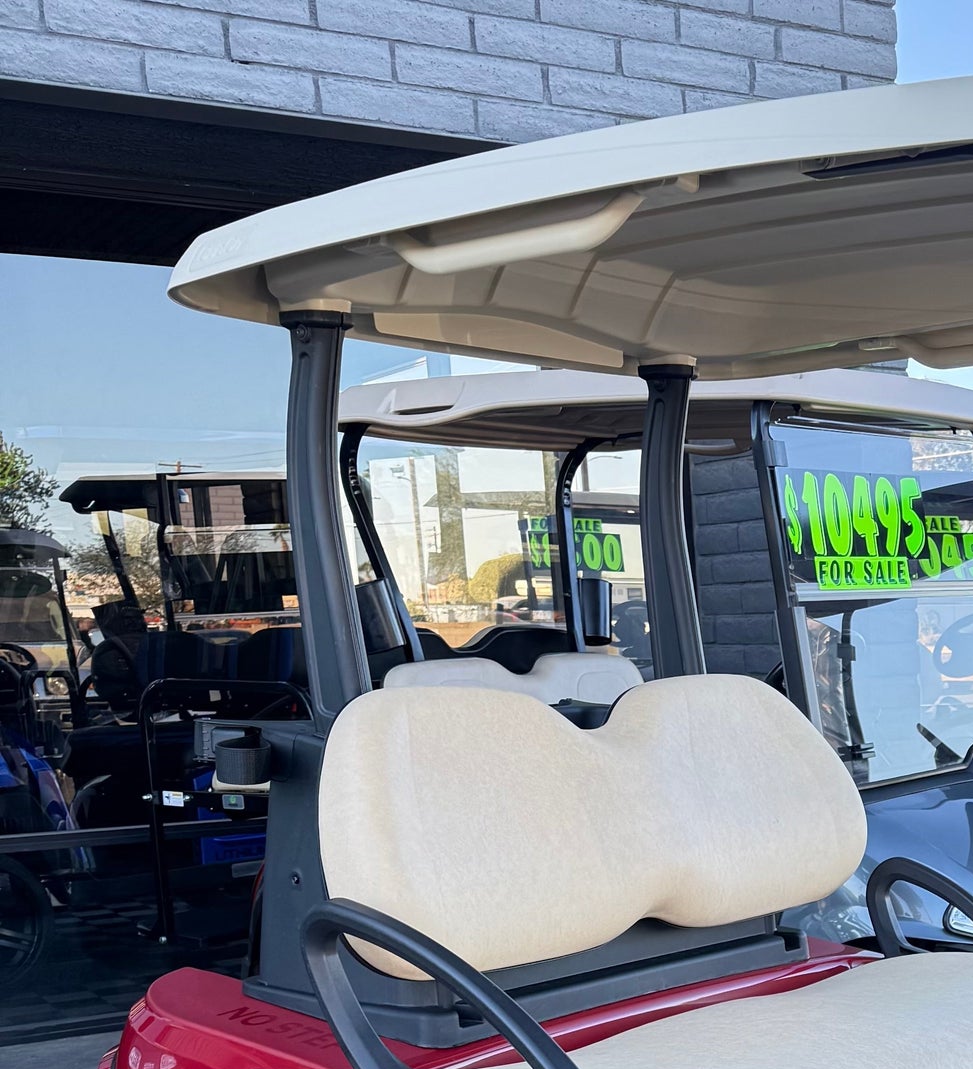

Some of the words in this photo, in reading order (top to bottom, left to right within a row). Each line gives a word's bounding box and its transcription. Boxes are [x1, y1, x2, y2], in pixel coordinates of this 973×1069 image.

[530, 518, 549, 530] FO
[574, 519, 602, 532] ALE
[784, 471, 926, 559] $10495
[927, 517, 959, 532] ALE
[818, 560, 857, 587] FOR
[863, 560, 907, 585] SALE
[217, 1006, 277, 1026] NO
